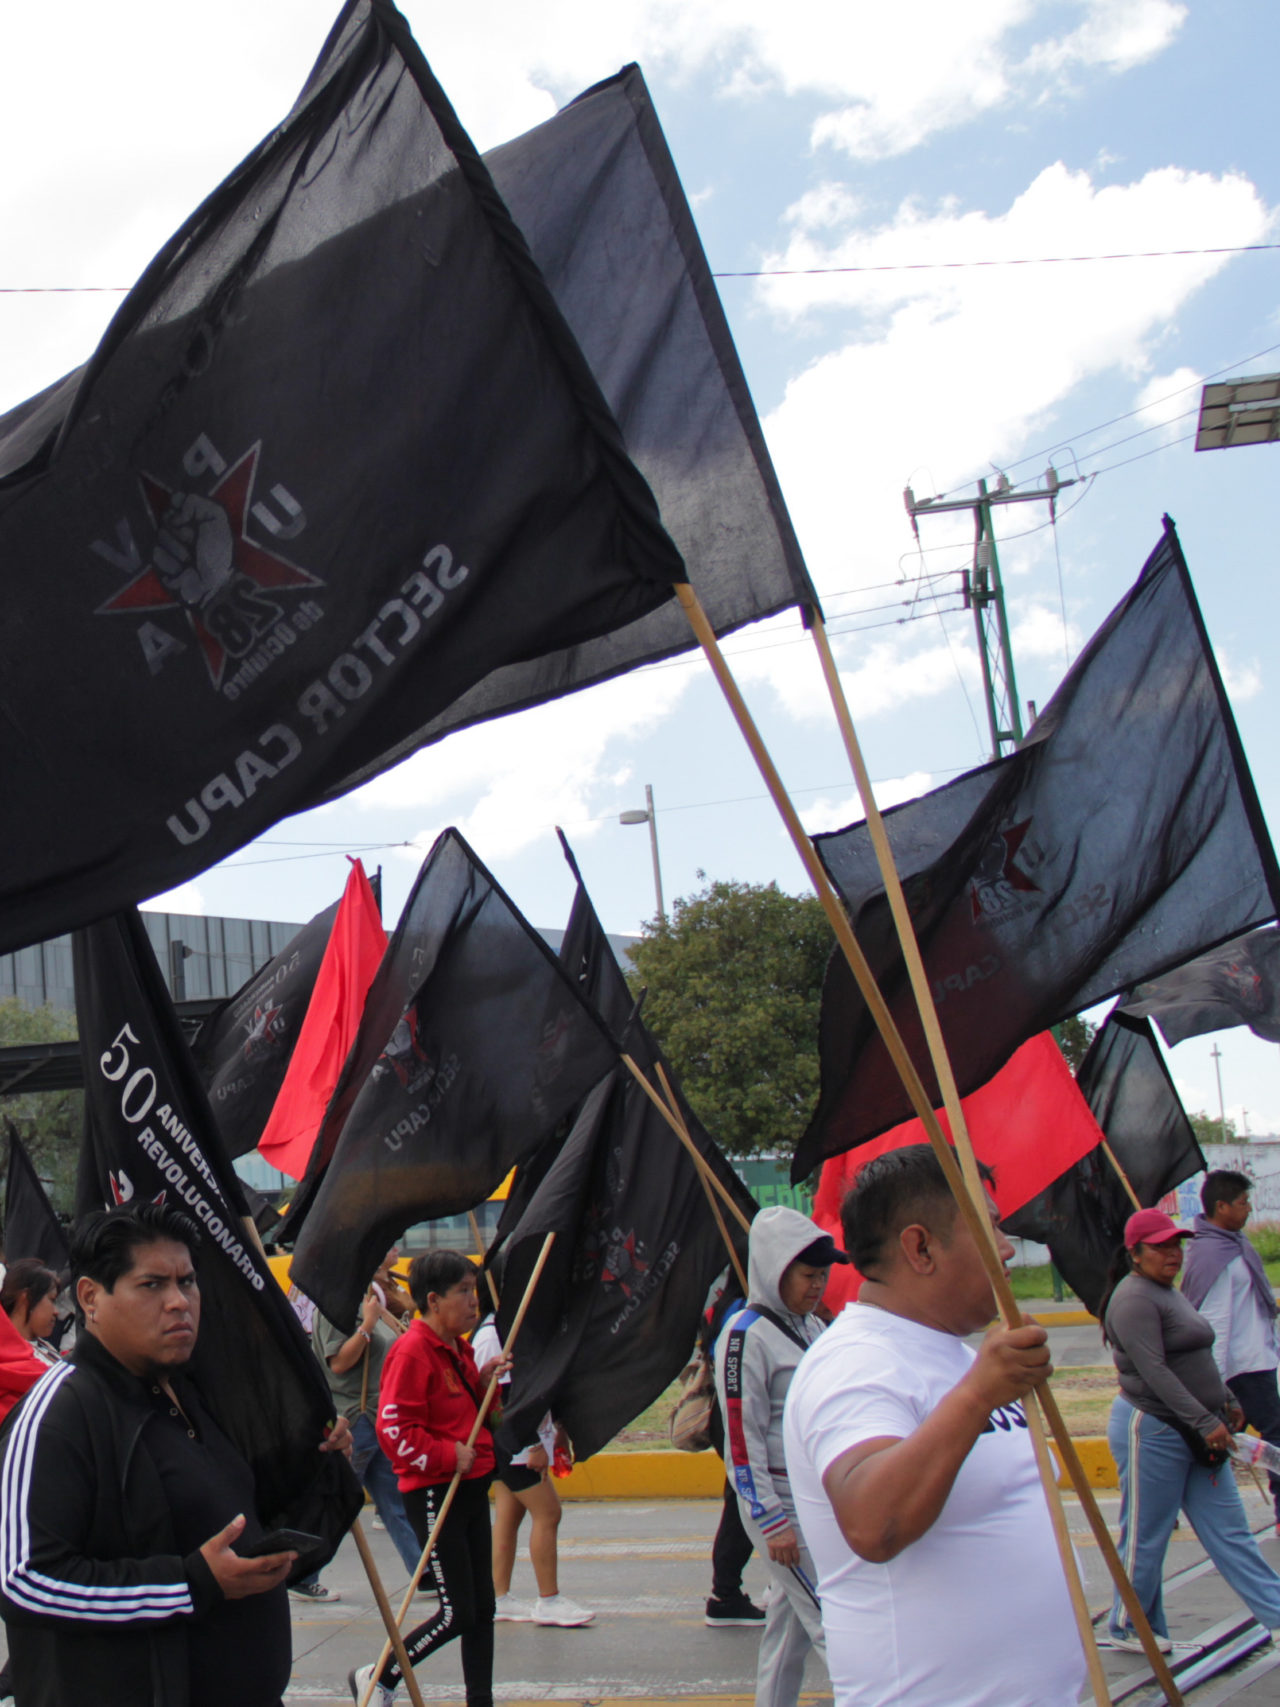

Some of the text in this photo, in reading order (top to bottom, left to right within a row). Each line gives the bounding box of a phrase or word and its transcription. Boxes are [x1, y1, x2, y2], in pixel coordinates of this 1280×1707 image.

[99, 1021, 158, 1124] 50
[730, 1337, 741, 1352] NR
[727, 1356, 739, 1393] SPORT
[381, 1403, 428, 1472] UPVA
